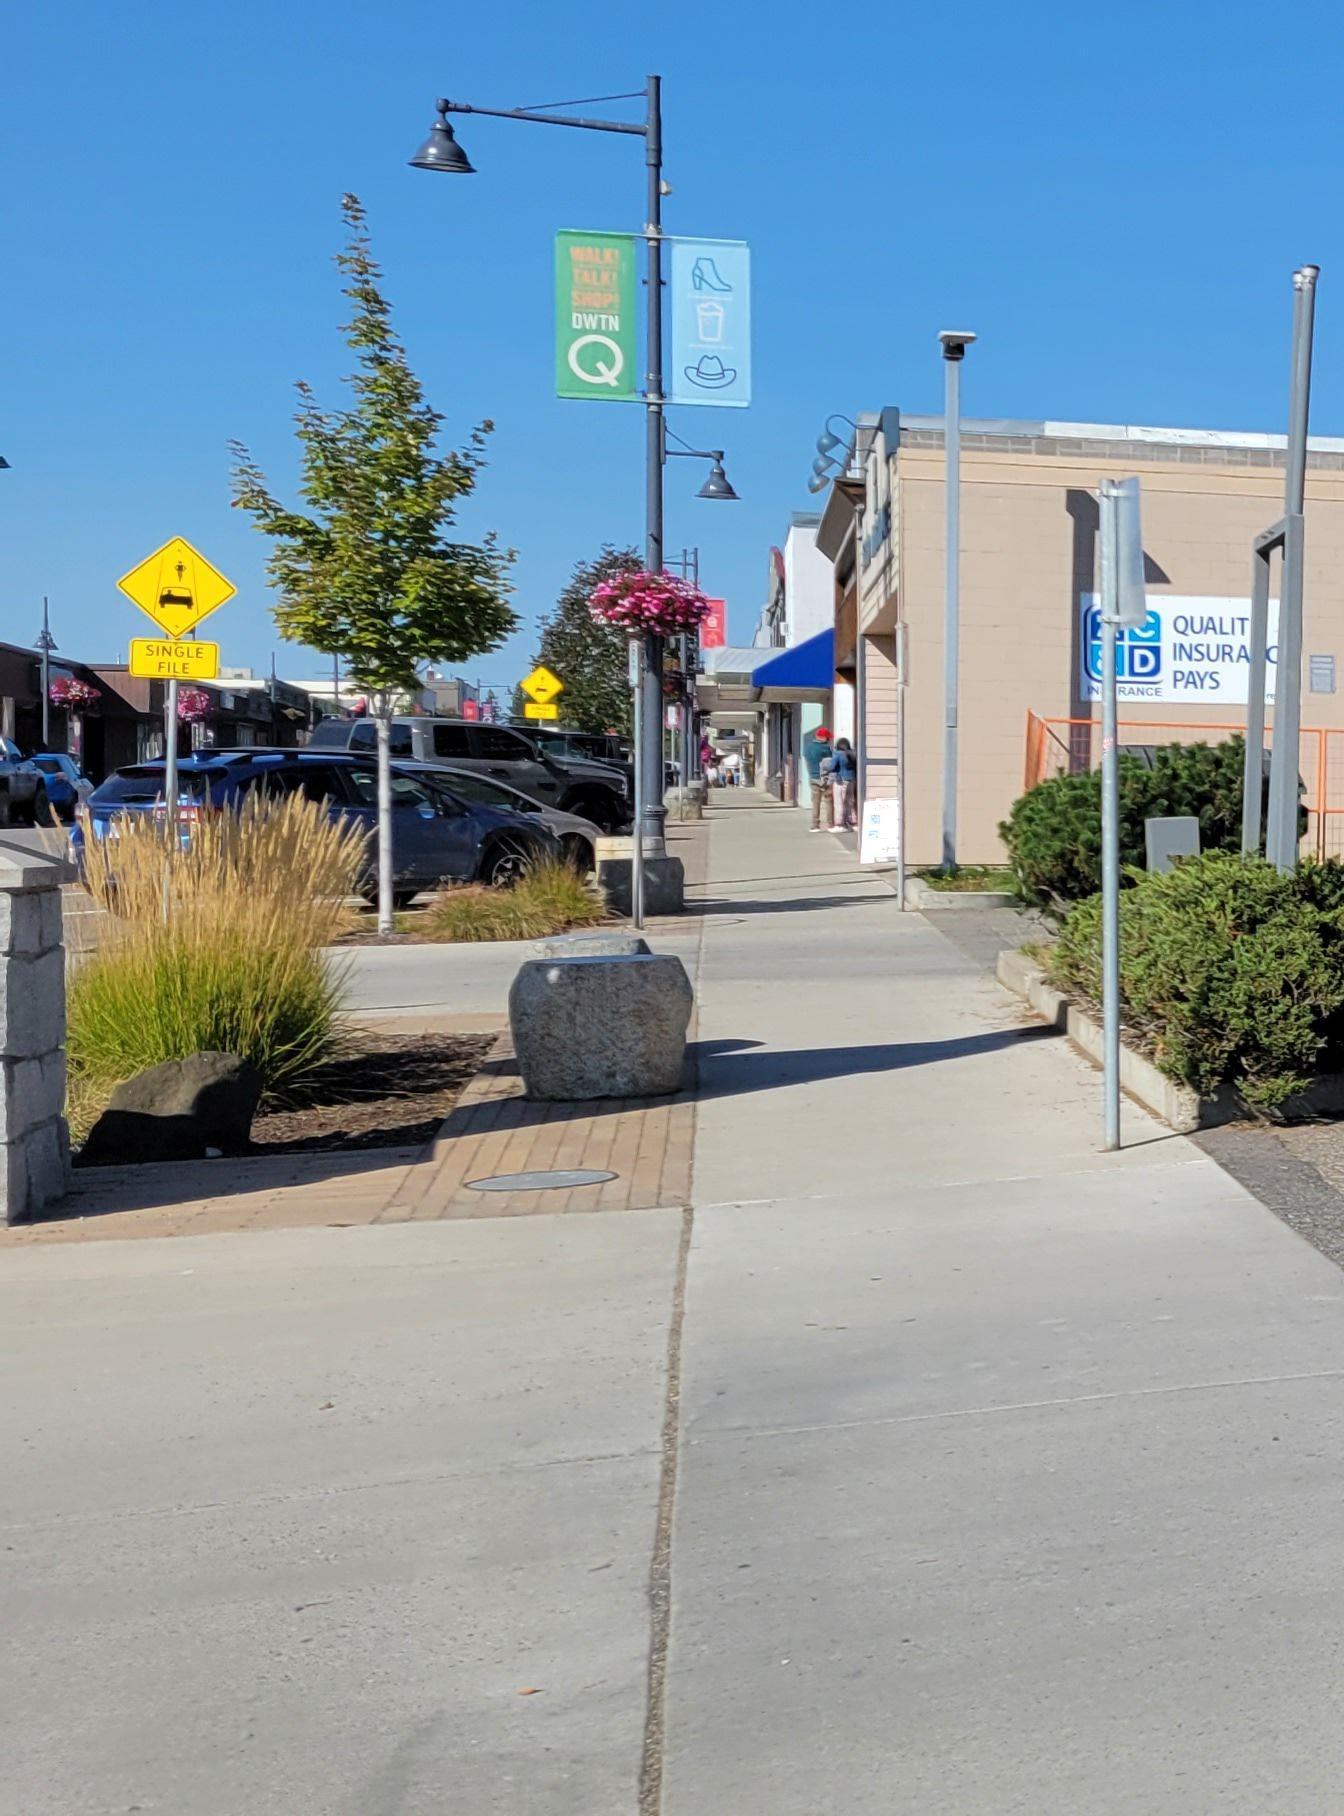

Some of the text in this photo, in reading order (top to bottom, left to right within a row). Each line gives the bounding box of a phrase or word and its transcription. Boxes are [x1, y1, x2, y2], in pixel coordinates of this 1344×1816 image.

[570, 246, 620, 265] WALK!
[573, 268, 618, 286] TALK!
[571, 290, 620, 309] SHOP!
[572, 312, 620, 332] DWTN
[567, 334, 624, 387] Q
[1172, 614, 1250, 637] QUALIT
[145, 644, 204, 659] SINGLE
[1133, 648, 1156, 674] D
[1172, 642, 1279, 664] INSURAC
[157, 661, 190, 674] FILE
[1172, 670, 1221, 690] PAYS
[1086, 685, 1163, 697] INRANCE
